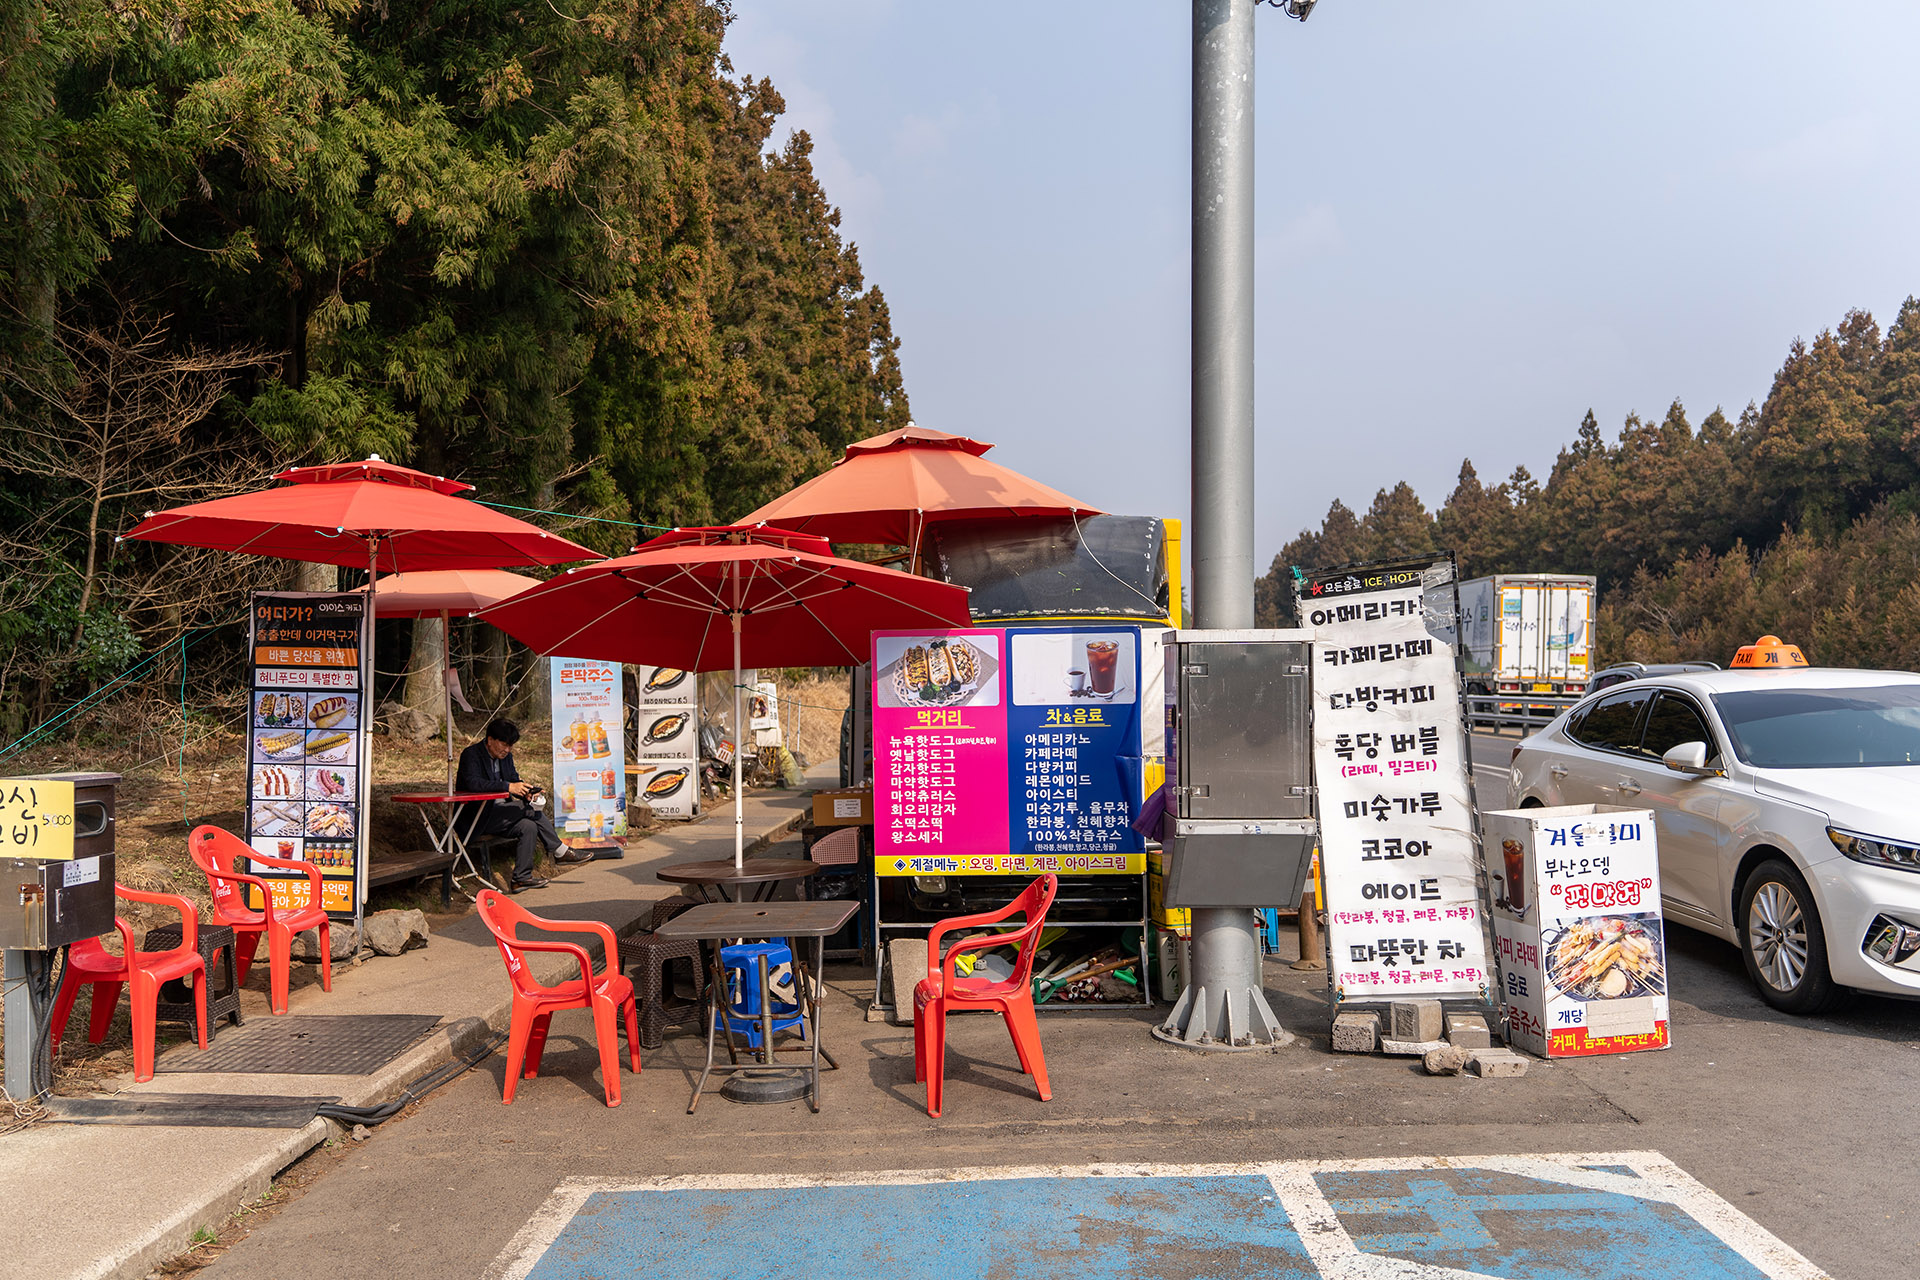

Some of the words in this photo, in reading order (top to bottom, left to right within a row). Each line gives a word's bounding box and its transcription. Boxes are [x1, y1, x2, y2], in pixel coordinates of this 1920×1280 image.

[1324, 579, 1362, 593] 모든음료
[1364, 576, 1387, 588] ICE,
[1389, 573, 1414, 584] HOT
[257, 606, 313, 622] 어디가?
[1310, 594, 1423, 626] 아메리카
[256, 629, 302, 641] 출출한데
[268, 649, 289, 662] 바쁜
[293, 649, 322, 663] 당신을
[325, 650, 345, 664] 위한
[1324, 639, 1433, 667] 카페라떼
[1736, 653, 1753, 664] TAXI
[312, 672, 341, 686] 특별한
[344, 673, 354, 686] 맛
[560, 668, 614, 684] 몬딱주스
[1329, 685, 1435, 713] 다방커피
[917, 709, 962, 726] 먹거리
[1046, 708, 1104, 725] 차&음료
[889, 735, 955, 748] 뉴욕핫도그
[1024, 733, 1091, 746] 아메리카노
[1334, 732, 1383, 761] 흑당
[1390, 726, 1440, 756] 버블
[889, 749, 956, 762] 옛날핫도그
[1024, 747, 1078, 760] 카페라떼
[890, 763, 956, 775] 감자핫도그
[1025, 761, 1077, 774] 다방커피
[1341, 764, 1384, 778] (라떼,
[1388, 759, 1438, 776] 밀크티)
[890, 776, 956, 789] 마약핫도그
[1025, 774, 1092, 787] 레몬에이드
[891, 789, 957, 802] 마약츄러스
[1026, 788, 1078, 801] 아이스티
[890, 803, 957, 816] 회오리감자
[1026, 802, 1084, 815] 미숫가루,
[1089, 801, 1129, 814] 율무차
[1343, 791, 1442, 822] 미숫가루
[891, 817, 943, 830] 소떡소떡
[1026, 816, 1071, 829] 한라봉,
[1077, 815, 1130, 828] 천혜향차
[0, 824, 38, 847] 비
[891, 830, 943, 844] 왕소세지
[1361, 838, 1433, 862] 코코아
[909, 857, 959, 871] 계절메뉴
[968, 857, 998, 872] 오뎅,
[1001, 857, 1029, 872] 라면,
[1033, 857, 1062, 872] 계란,
[1065, 856, 1127, 871] 아이스크림
[1545, 856, 1610, 879] 부산오뎅
[254, 881, 287, 895] 주의
[291, 882, 311, 896] 좋은
[1361, 878, 1442, 901] 에이드
[1333, 910, 1379, 924] (한라봉,
[1382, 909, 1410, 923] 청귤,
[1413, 908, 1442, 922] 레몬,
[1445, 906, 1475, 921] 자몽)
[1350, 938, 1429, 967] 따뜻한
[1437, 939, 1465, 960] 차
[1339, 971, 1385, 985] (한라봉,
[1420, 968, 1448, 983] 레몬,
[1452, 967, 1482, 982] 자몽)
[1507, 971, 1529, 998] 음료
[1500, 1005, 1542, 1037] 즙쥬스
[1558, 1009, 1583, 1024] 개당
[1553, 1033, 1581, 1051] 커피,
